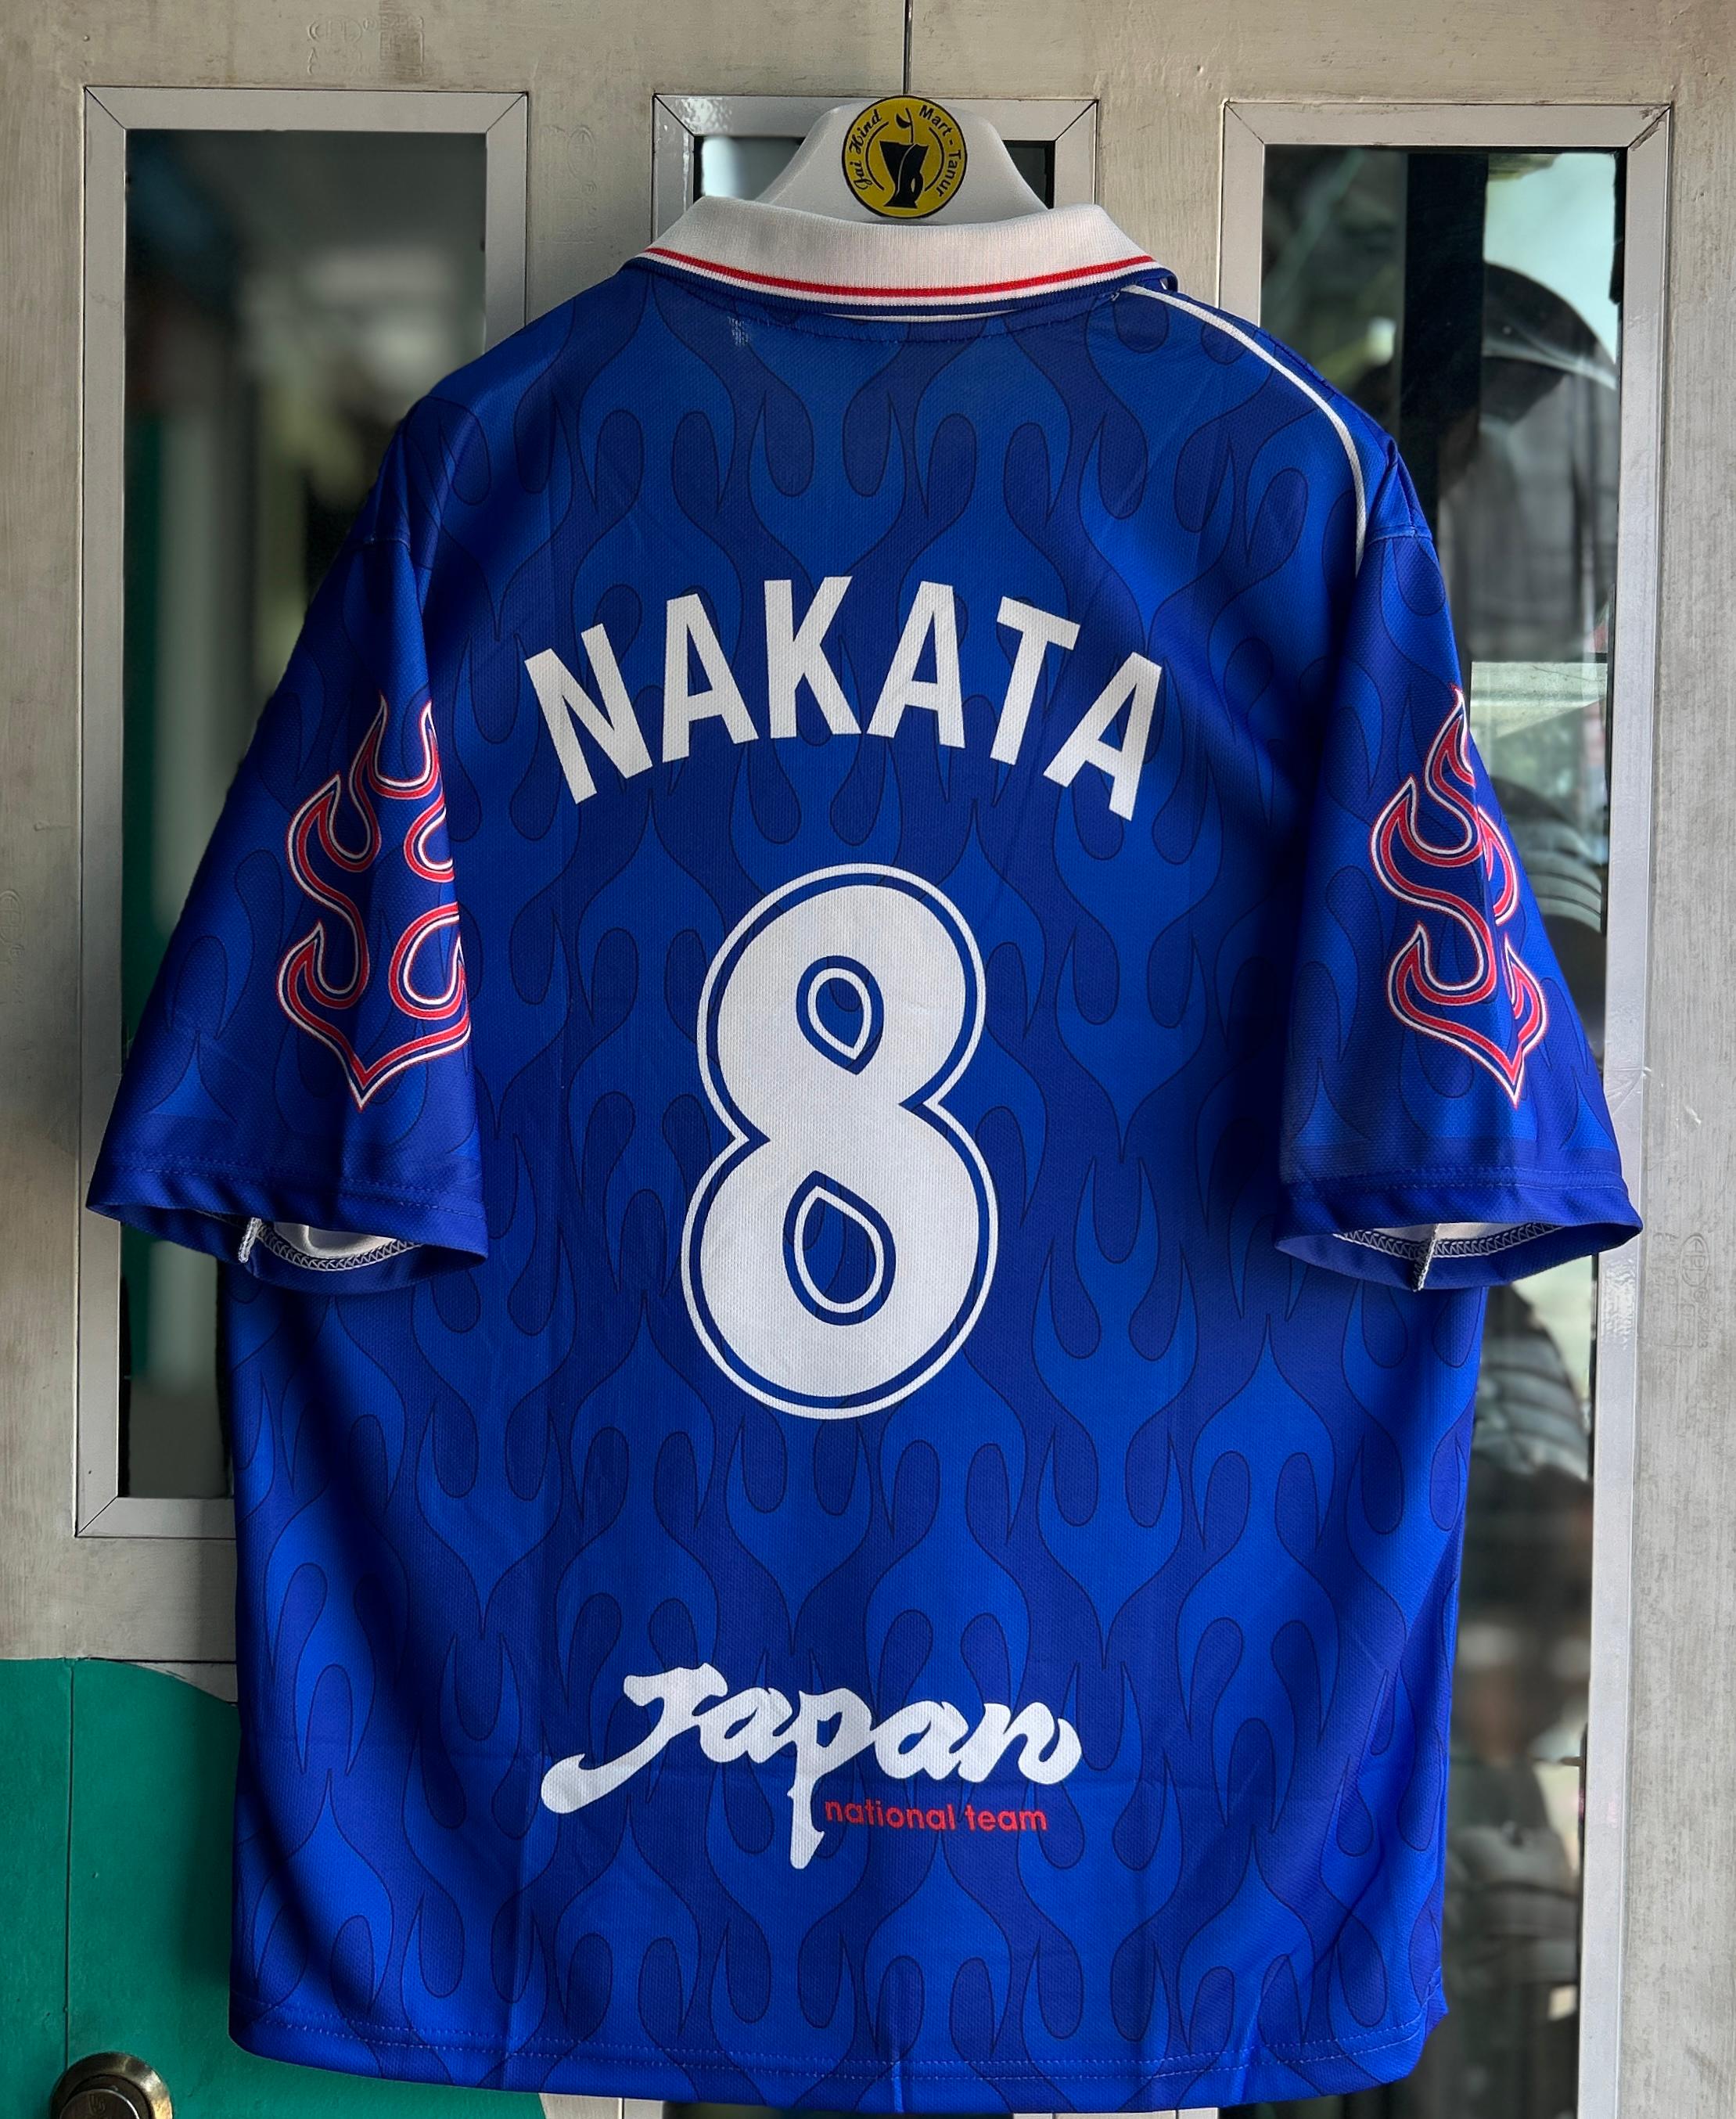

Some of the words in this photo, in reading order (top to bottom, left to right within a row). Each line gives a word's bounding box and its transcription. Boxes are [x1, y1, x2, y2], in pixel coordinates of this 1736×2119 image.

[848, 108, 882, 154] Hind
[918, 104, 953, 137] Mart
[936, 149, 961, 197] Tanur
[524, 575, 1163, 821] NAKATA
[680, 862, 999, 1420] 8
[540, 1661, 1083, 1870] Japan
[825, 1799, 956, 1830] national
[965, 1804, 1048, 1832] team
